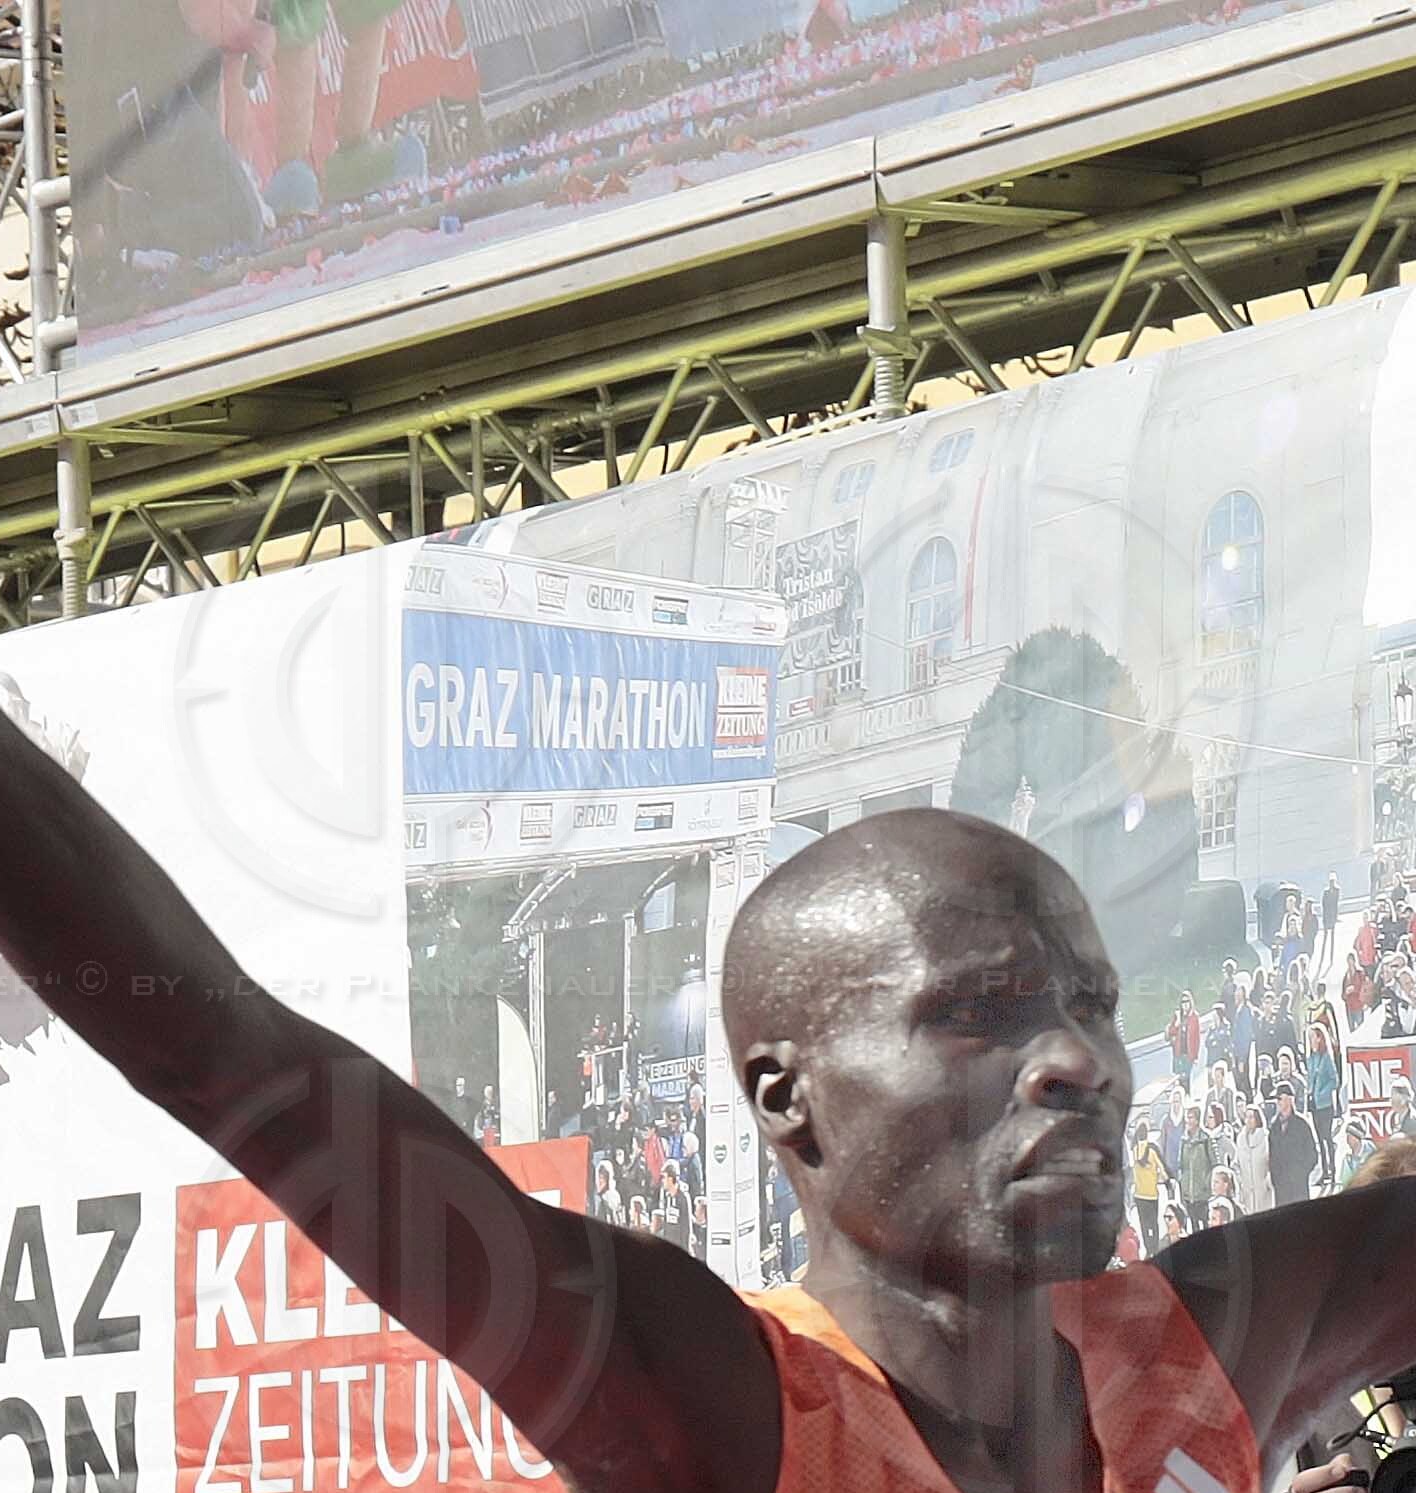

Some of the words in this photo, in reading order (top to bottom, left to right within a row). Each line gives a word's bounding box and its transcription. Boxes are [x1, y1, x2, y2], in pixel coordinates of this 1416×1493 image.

[405, 661, 521, 749] GRAZ
[532, 672, 707, 750] MARATHON
[715, 711, 767, 742] ZEITUNG
